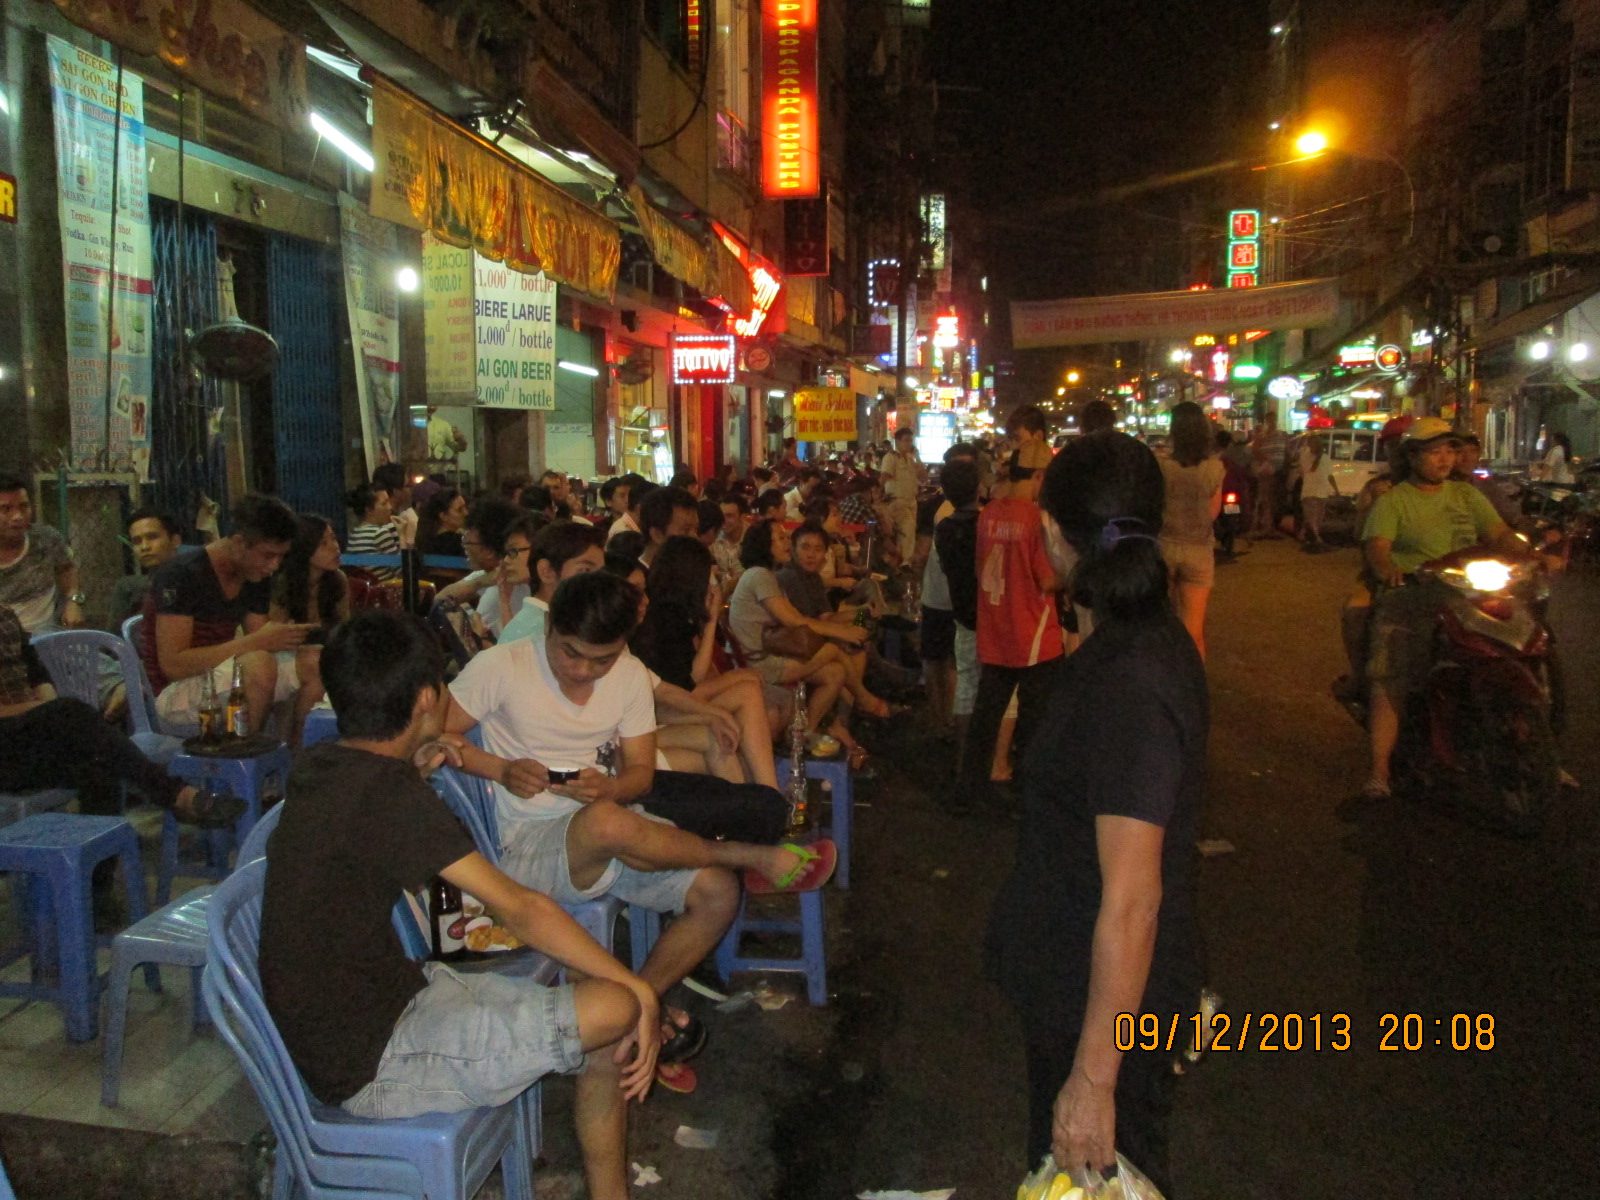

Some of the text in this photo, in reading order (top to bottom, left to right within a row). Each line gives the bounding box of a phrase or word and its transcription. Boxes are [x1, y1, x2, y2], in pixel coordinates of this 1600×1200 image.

[778, 19, 800, 115] PROPAGANDA
[81, 69, 105, 86] GON
[107, 79, 128, 97] RD
[778, 122, 800, 188] POSTERS
[521, 274, 554, 293] bottle
[475, 299, 552, 322] BIERE LARUE
[520, 328, 553, 350] bottle
[1194, 336, 1216, 346] SPA
[493, 359, 518, 379] GON
[522, 361, 552, 381] BEER
[674, 348, 730, 372] TATTOO
[519, 387, 552, 407] bottle
